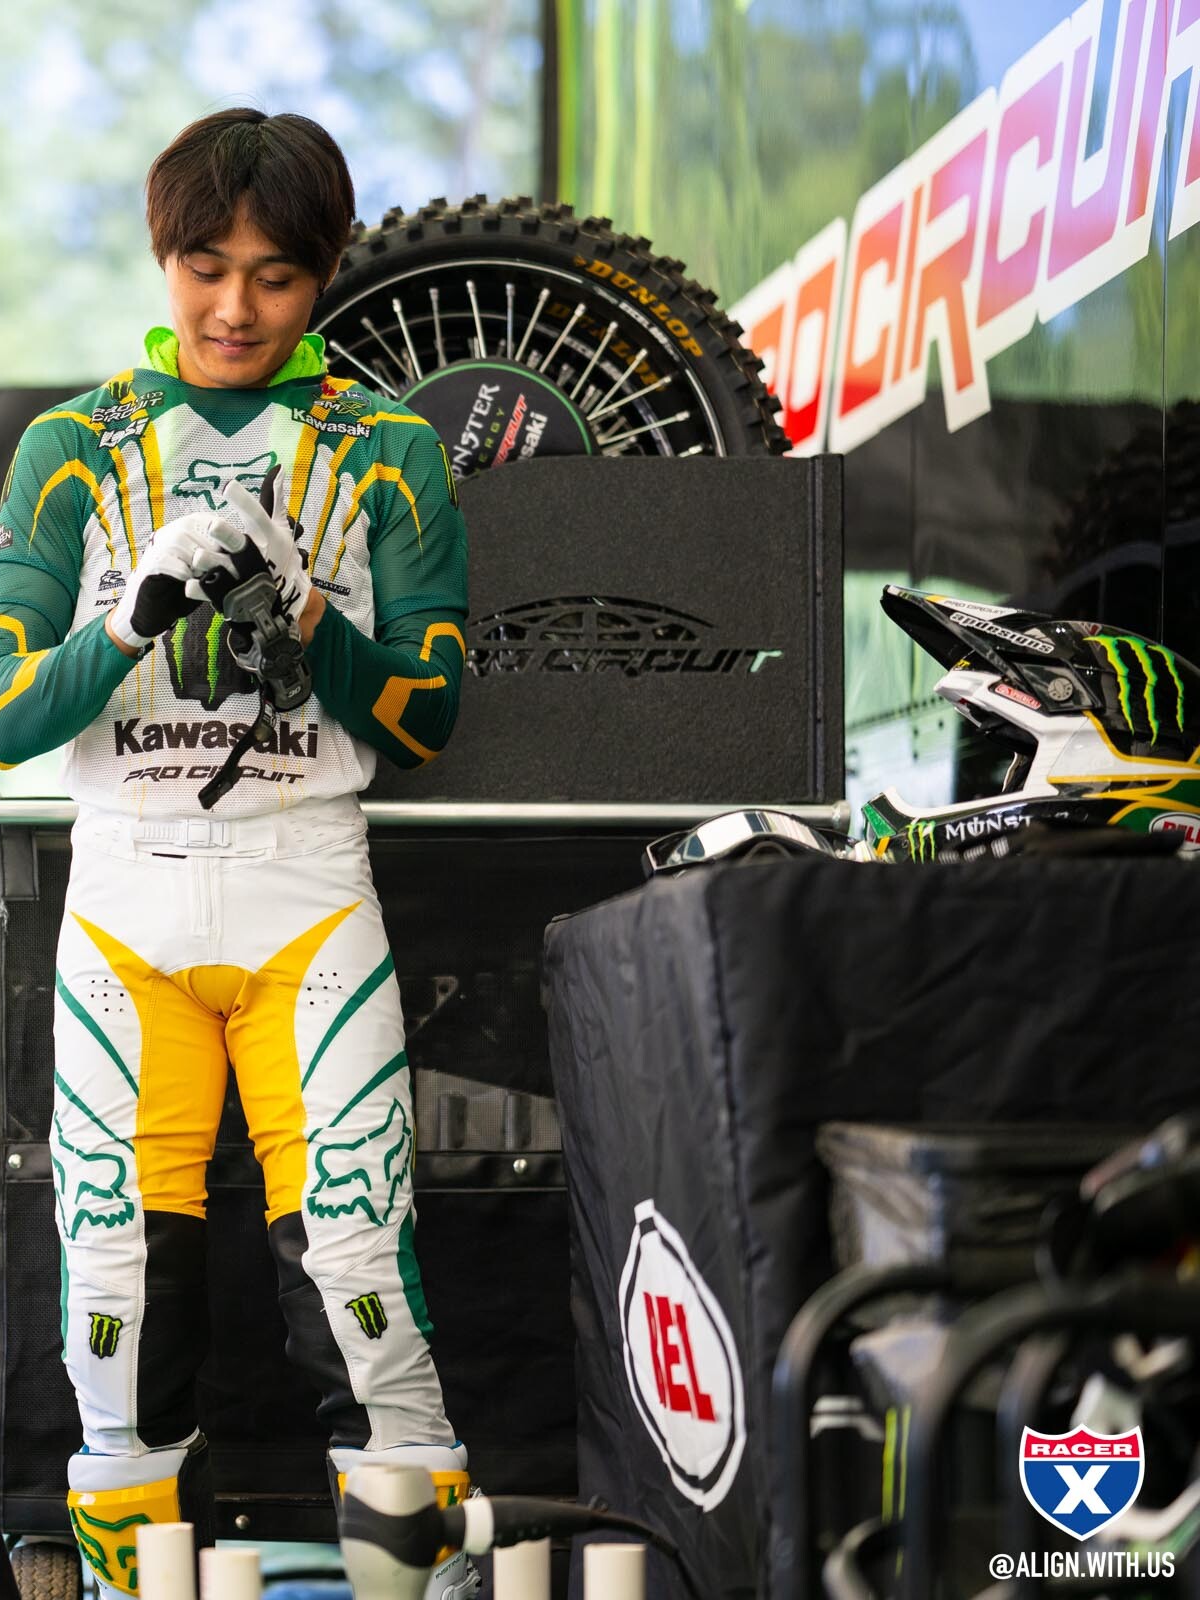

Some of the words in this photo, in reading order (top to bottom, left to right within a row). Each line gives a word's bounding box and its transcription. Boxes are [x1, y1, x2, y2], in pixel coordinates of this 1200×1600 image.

[586, 259, 704, 357] DUNLOP
[292, 407, 371, 438] Kawasaki
[452, 384, 500, 481] ONSTER
[519, 411, 548, 460] saki
[95, 596, 123, 607] DUN
[950, 612, 1055, 654] apdesigns
[538, 648, 783, 678] CIRCUIT
[114, 717, 319, 759] Kawasaki
[123, 765, 184, 783] PRO
[185, 765, 305, 784] CICUIT
[945, 814, 1034, 842] MONST
